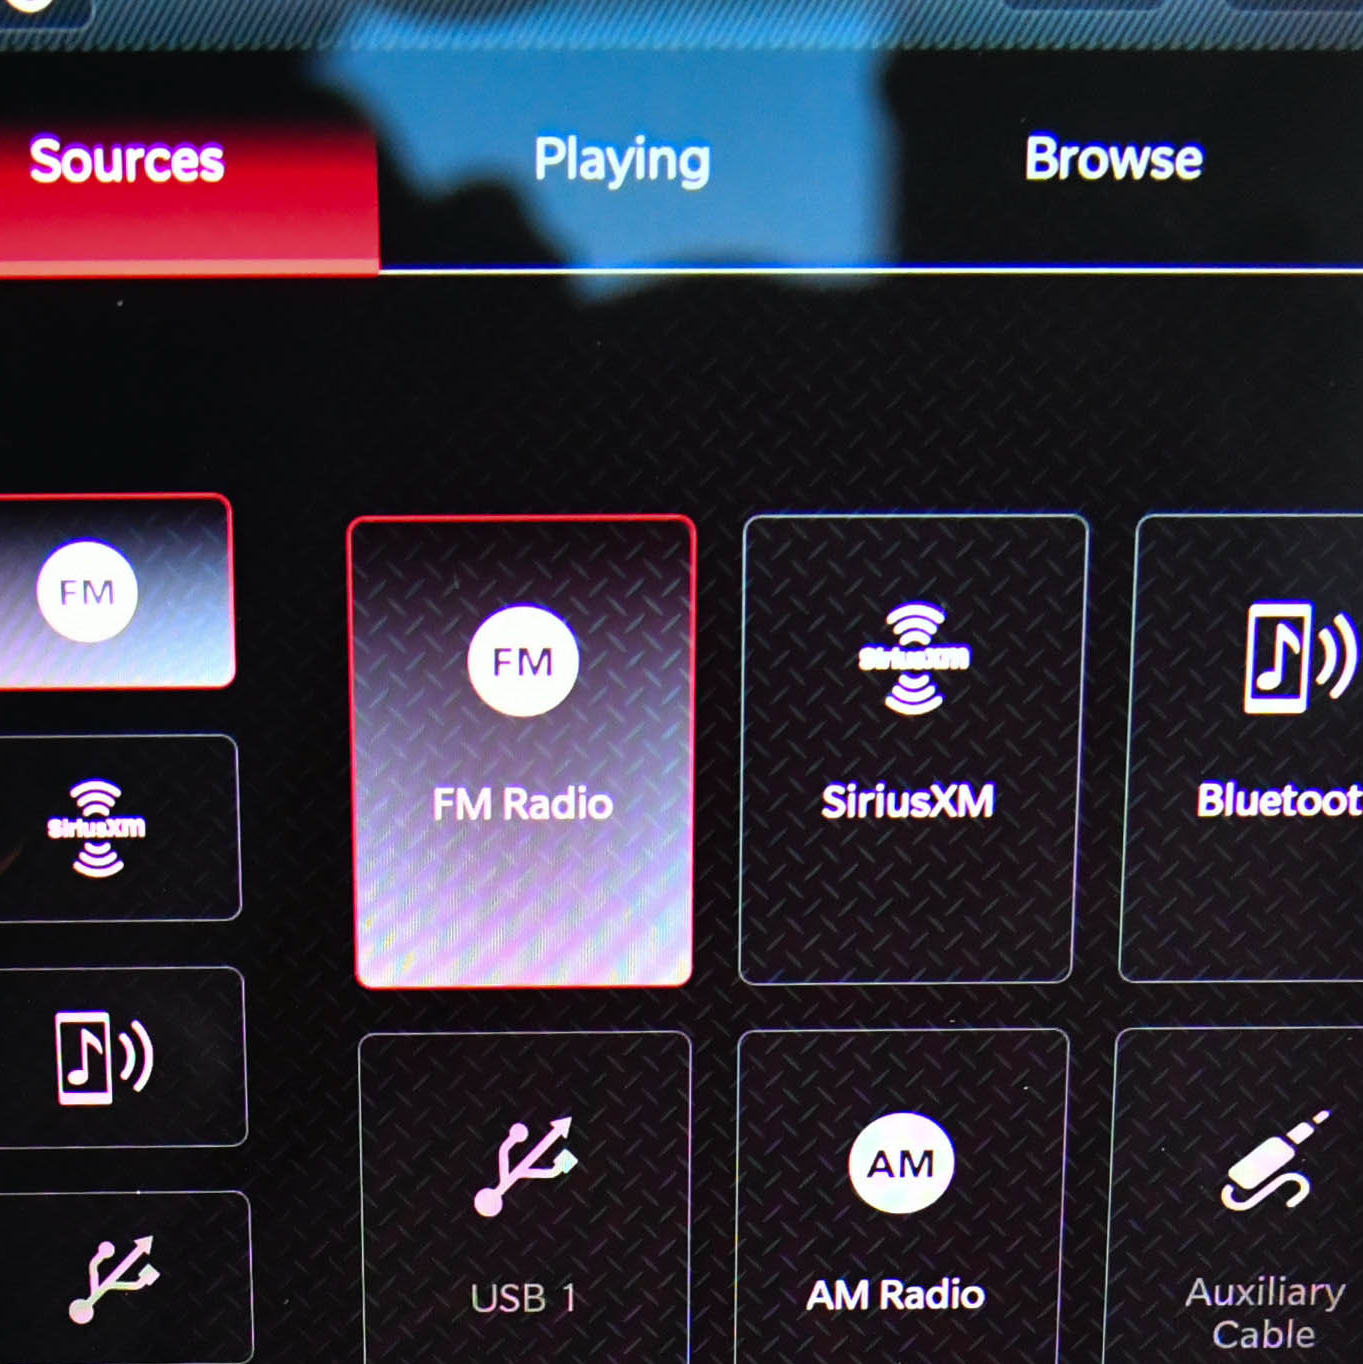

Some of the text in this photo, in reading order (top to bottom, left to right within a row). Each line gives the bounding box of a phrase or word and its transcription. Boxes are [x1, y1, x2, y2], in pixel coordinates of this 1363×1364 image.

[30, 137, 225, 183] Sources
[535, 134, 710, 192] Playing
[1026, 135, 1203, 180] Browse
[60, 579, 114, 606] FM
[494, 647, 552, 677] FM
[434, 784, 614, 822] FM Radio
[821, 782, 994, 819] SiriusXM
[866, 1149, 934, 1178] AM
[471, 1282, 574, 1313] USB 1
[806, 1276, 986, 1311] AM Radio
[1185, 1275, 1347, 1316] Auxiliary
[1212, 1318, 1315, 1349] Cable
